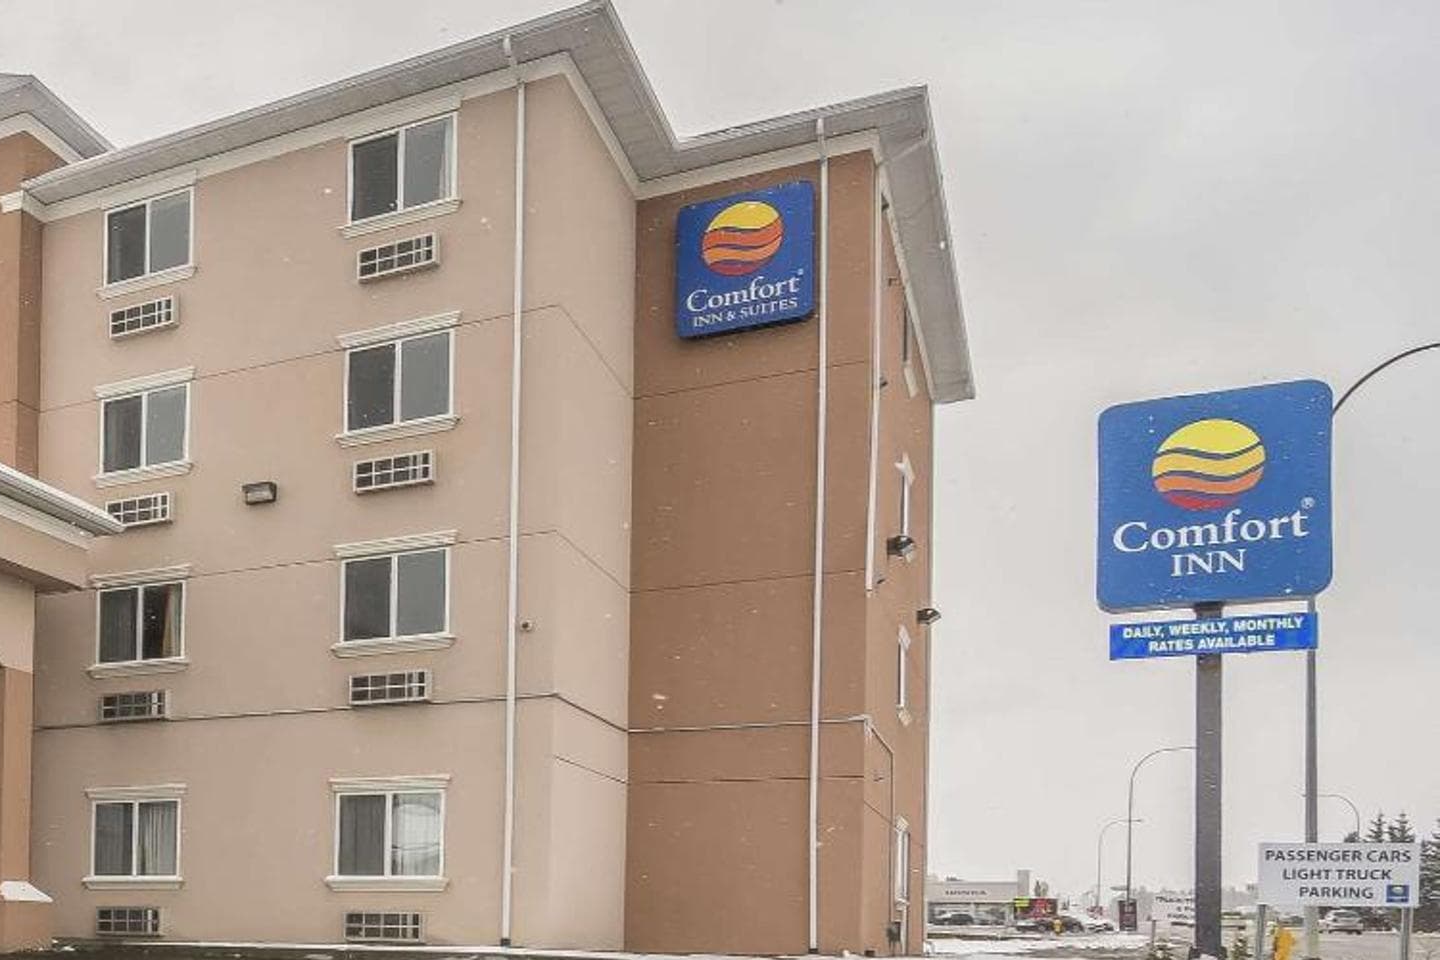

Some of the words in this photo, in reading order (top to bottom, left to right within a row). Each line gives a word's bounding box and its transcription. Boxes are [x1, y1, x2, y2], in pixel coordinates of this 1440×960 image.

[686, 276, 800, 312] Comfort
[693, 312, 722, 327] INN
[726, 310, 736, 321] &
[740, 297, 798, 319] SUITES
[1113, 508, 1309, 552] Comfort
[1171, 549, 1246, 577] INN
[1123, 626, 1164, 639] DAILY,
[1169, 621, 1229, 636] WEEKLY,
[1233, 616, 1304, 632] MONTHLY
[1148, 638, 1193, 653] RATES
[1197, 634, 1276, 650] AVAILABLE
[1265, 850, 1362, 862] PASSENGER
[1366, 850, 1412, 863] CARS
[1282, 868, 1333, 880] LIGHT
[1335, 868, 1392, 880] TRUCK
[1299, 886, 1374, 899] PARKING
